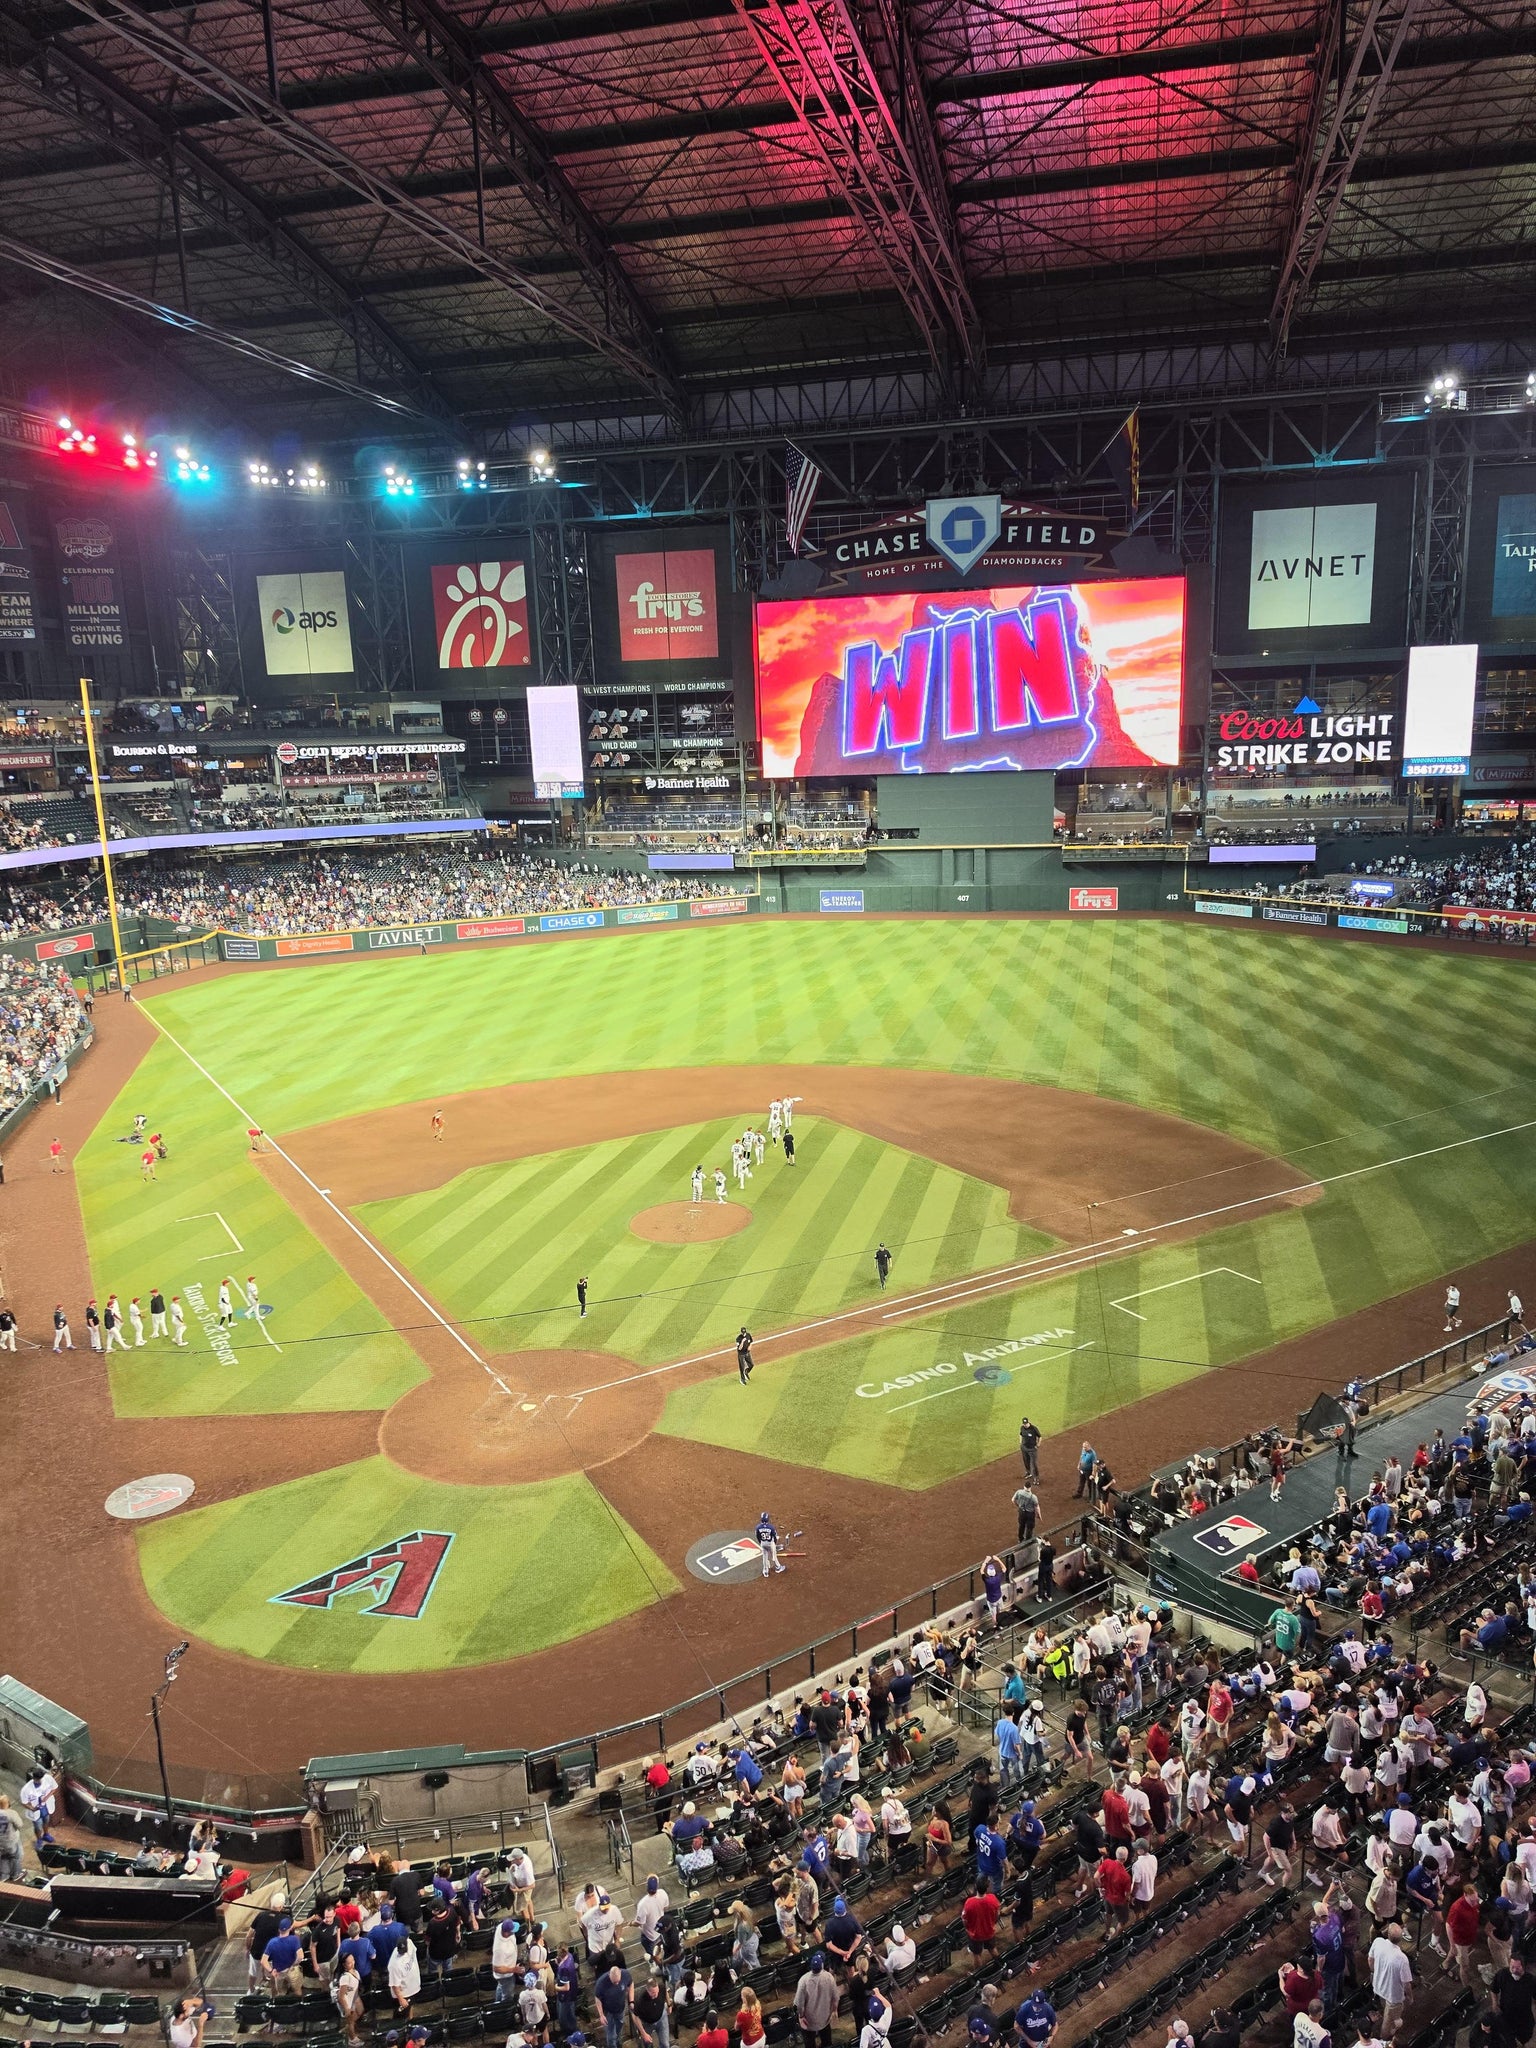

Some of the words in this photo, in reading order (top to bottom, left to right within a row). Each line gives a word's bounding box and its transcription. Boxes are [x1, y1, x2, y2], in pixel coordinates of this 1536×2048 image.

[836, 533, 920, 562] CHASE
[1007, 526, 1095, 545] FIELD
[83, 545, 106, 557] Back
[867, 567, 895, 578] HOME
[904, 564, 916, 573] OF
[924, 561, 943, 570] THE
[983, 558, 1062, 567] DIAMONDBACKS
[1257, 554, 1366, 581] AVNET
[629, 582, 703, 621] fry's
[68, 605, 120, 615] MILLION
[299, 609, 338, 632] aps
[670, 625, 703, 633] EVERYONE
[72, 634, 123, 645] GIVING
[843, 598, 1079, 757] WIN
[593, 686, 611, 694] WEST
[612, 685, 651, 694] CHAMPIONS
[664, 683, 686, 691] WORLD
[687, 682, 726, 691] CHAMPIONS
[1220, 710, 1305, 740] Coors
[1311, 715, 1393, 738] LIGHT
[601, 742, 618, 750] WILD
[619, 741, 638, 750] CARD
[683, 738, 724, 747] CHAMPIONS
[158, 745, 168, 755] &
[300, 747, 329, 757] COLD
[331, 746, 366, 756] BEERS
[377, 743, 466, 755] CHEESEBURGERS
[1218, 743, 1308, 766] STRIKE
[1315, 741, 1391, 763] ZONE
[29, 756, 43, 764] SEATS
[314, 776, 327, 785] Your
[328, 775, 363, 785] Neighborhood
[364, 774, 382, 783] Burger
[384, 773, 398, 782] Joint
[1501, 770, 1533, 779] FITNESS
[658, 777, 694, 789] Banner
[696, 776, 730, 788] Health
[1074, 890, 1113, 908] fry's
[548, 916, 585, 928] CHASE
[1275, 911, 1299, 921] Banner
[1300, 914, 1322, 923] Health
[483, 924, 519, 934] Budweiser
[527, 925, 539, 933] 374
[1347, 918, 1369, 928] COX
[1376, 920, 1400, 930] COX
[1409, 924, 1422, 932] 374
[378, 928, 434, 945] AVNET
[183, 1282, 209, 1315] TALKING
[210, 1332, 239, 1366] RESORT
[855, 1363, 957, 1398] CASINO
[962, 1328, 1076, 1367] ARIZONA
[1113, 1625, 1122, 1635] 18
[1276, 1620, 1289, 1635] 29
[924, 1650, 931, 1658] 16
[1350, 1651, 1358, 1662] 17
[695, 1767, 706, 1777] 50
[980, 1833, 992, 1846] BETTS
[978, 1841, 991, 1857] 50
[529, 2003, 535, 2012] 7
[1027, 2017, 1047, 2028] Dodgers
